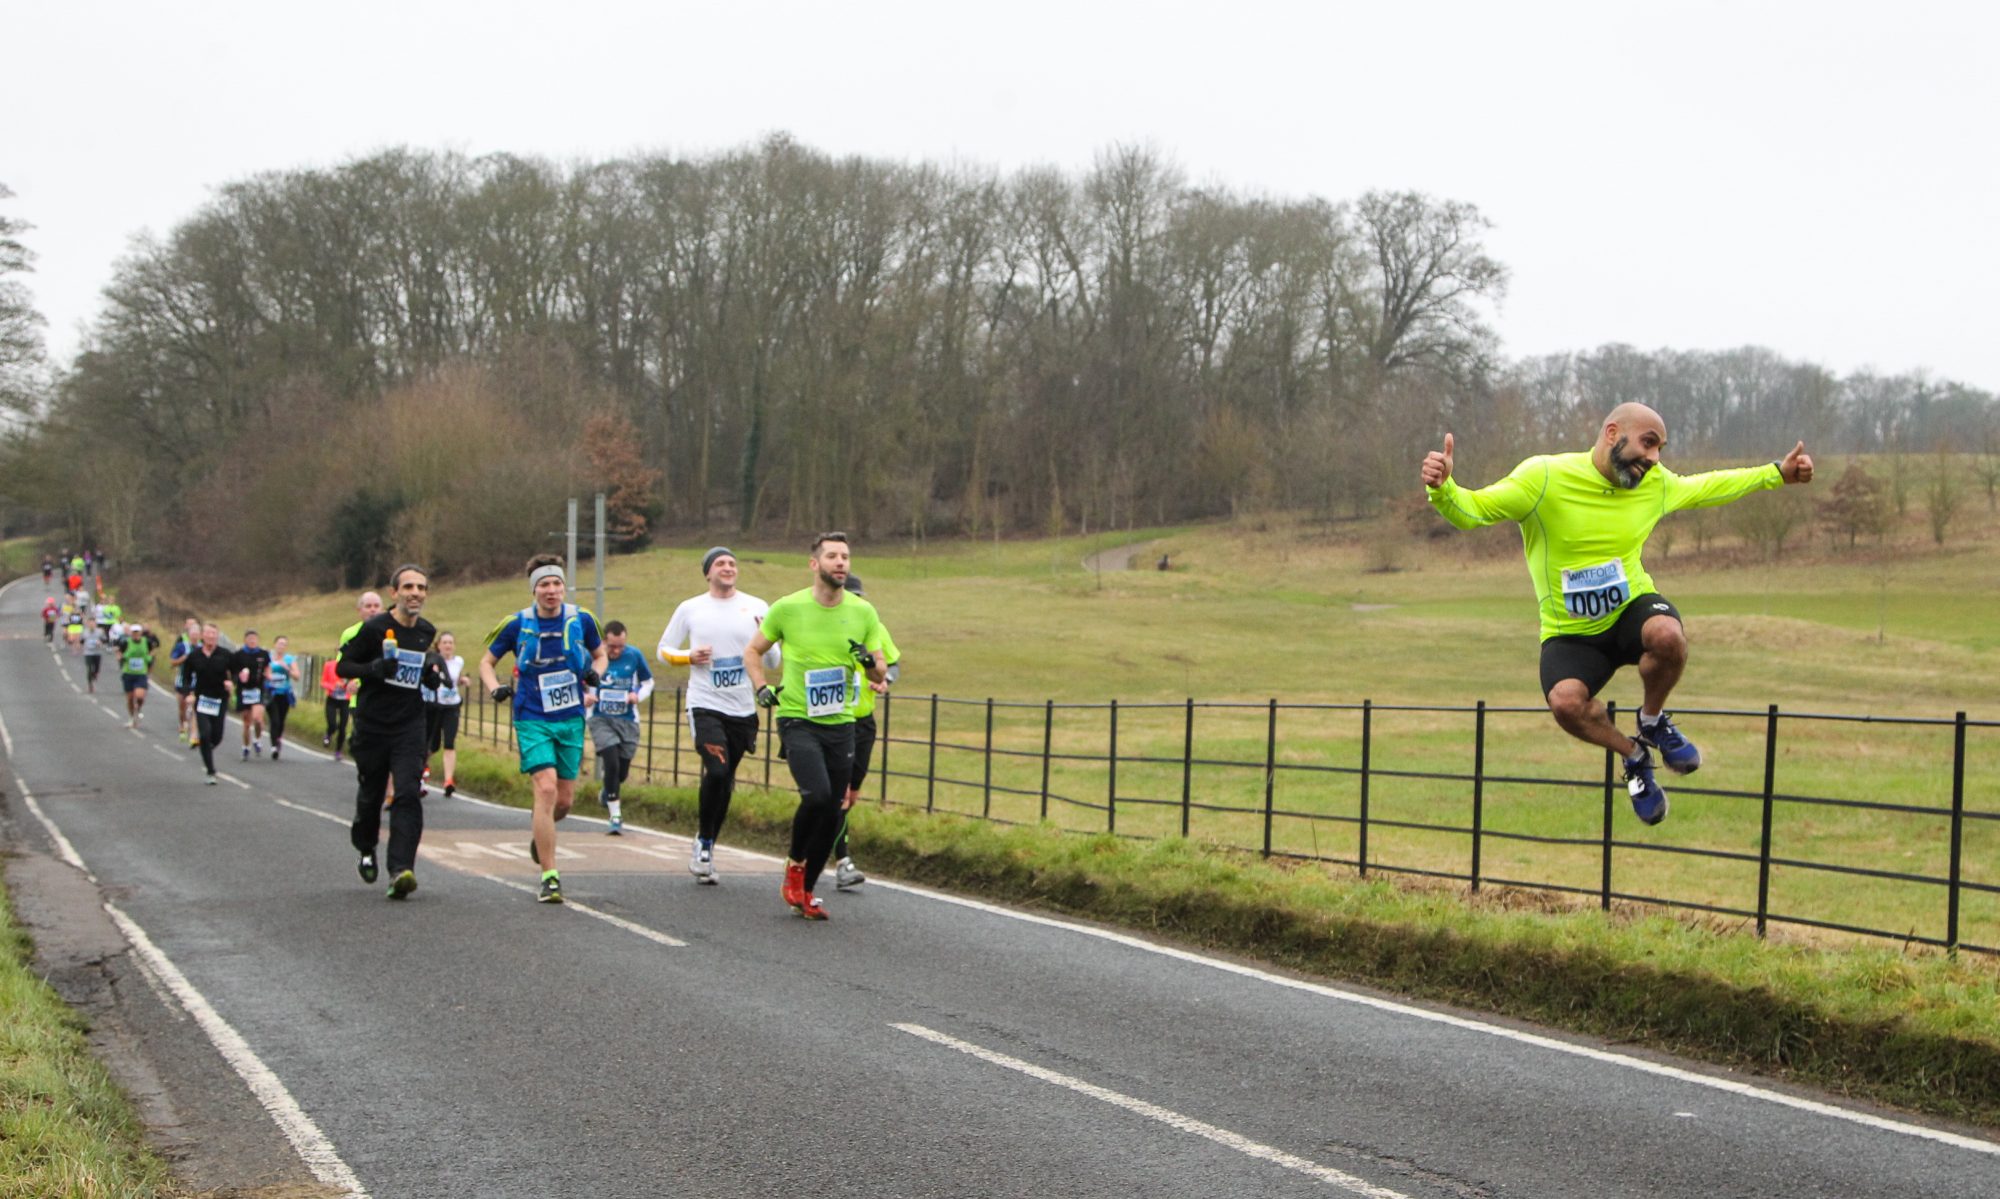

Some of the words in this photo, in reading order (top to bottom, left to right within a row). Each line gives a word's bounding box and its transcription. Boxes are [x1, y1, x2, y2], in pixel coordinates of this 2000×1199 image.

[1572, 586, 1623, 617] 0019
[713, 668, 743, 688] 0827
[547, 683, 574, 707] 1951
[810, 683, 844, 706] 0678
